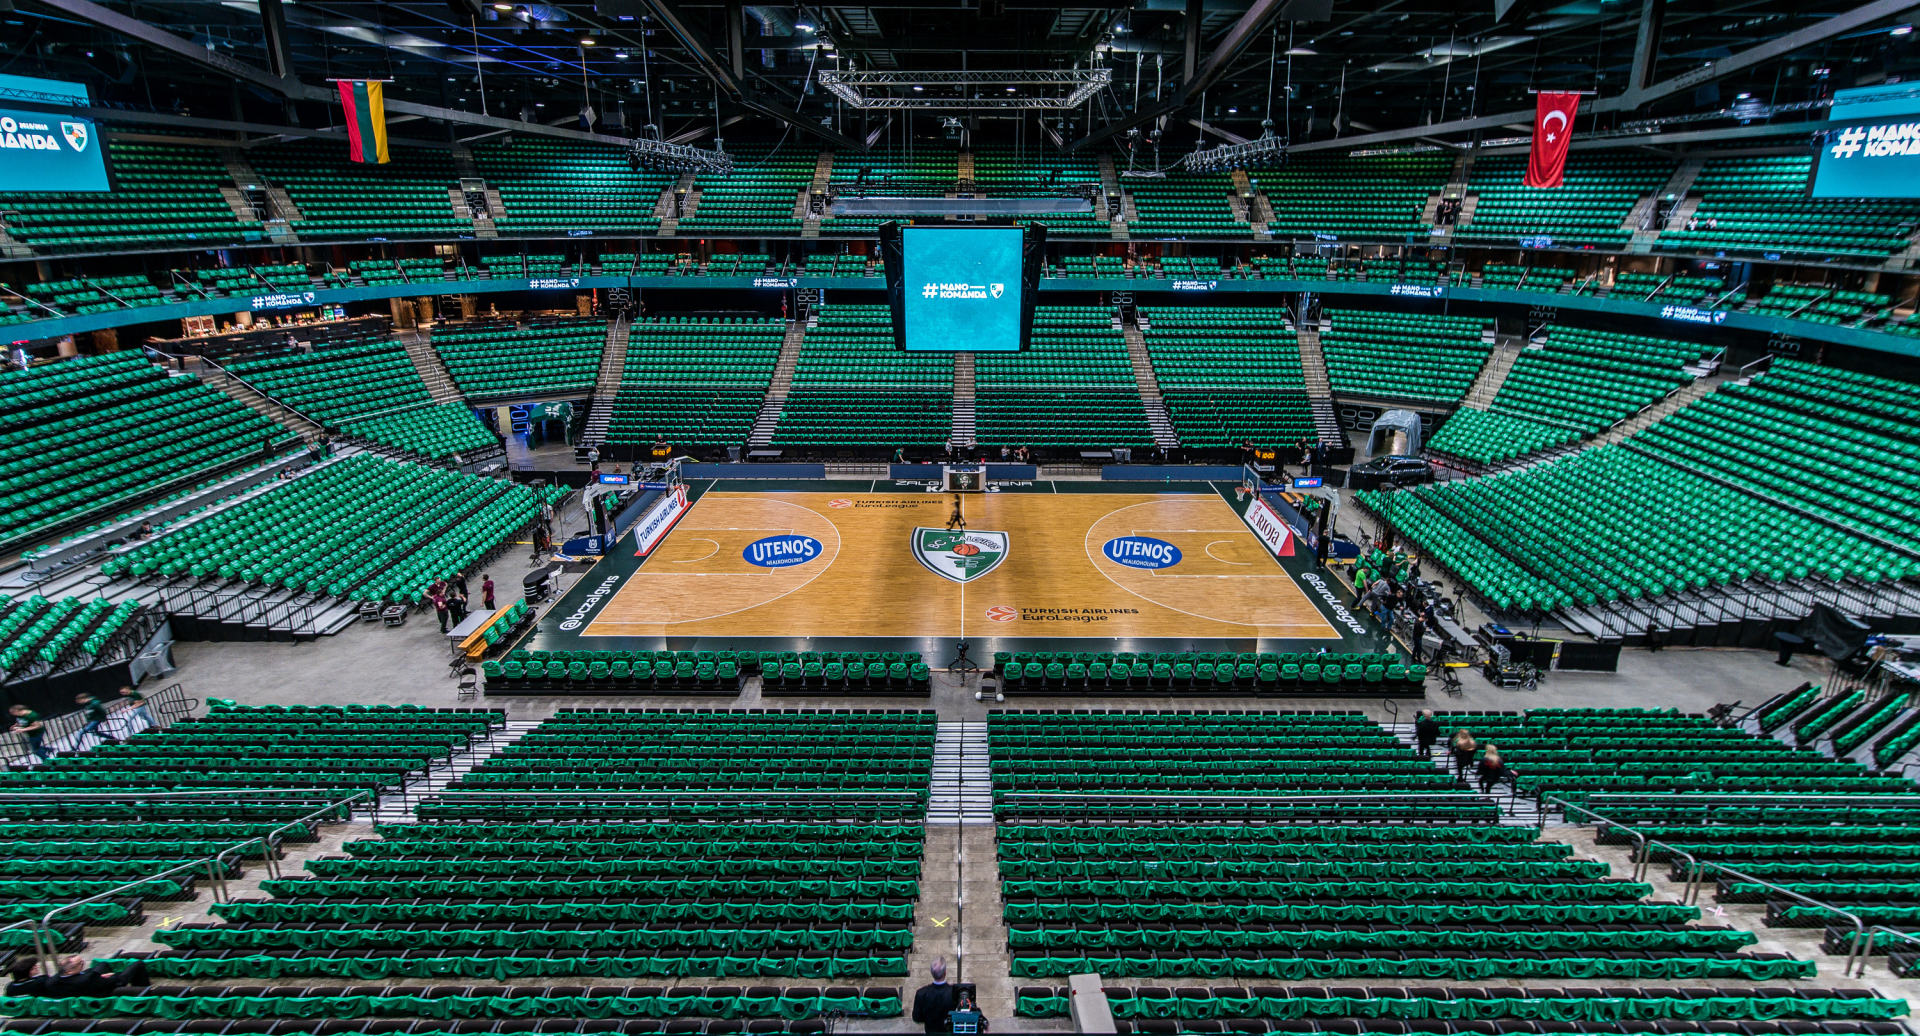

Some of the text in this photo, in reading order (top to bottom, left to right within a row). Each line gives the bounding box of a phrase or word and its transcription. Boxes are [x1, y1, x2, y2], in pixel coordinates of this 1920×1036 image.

[940, 283, 969, 291] MANO
[940, 290, 988, 299] KOMANDA
[265, 298, 303, 307] KOMANDA
[639, 497, 678, 543] TURKISH AIRLINES
[752, 538, 814, 562] UTENOS
[1112, 539, 1174, 564] UTENOS
[558, 575, 620, 631] @bczalgiris
[1300, 572, 1367, 634] @EuroLeague
[1022, 614, 1109, 623] EuroLeague
